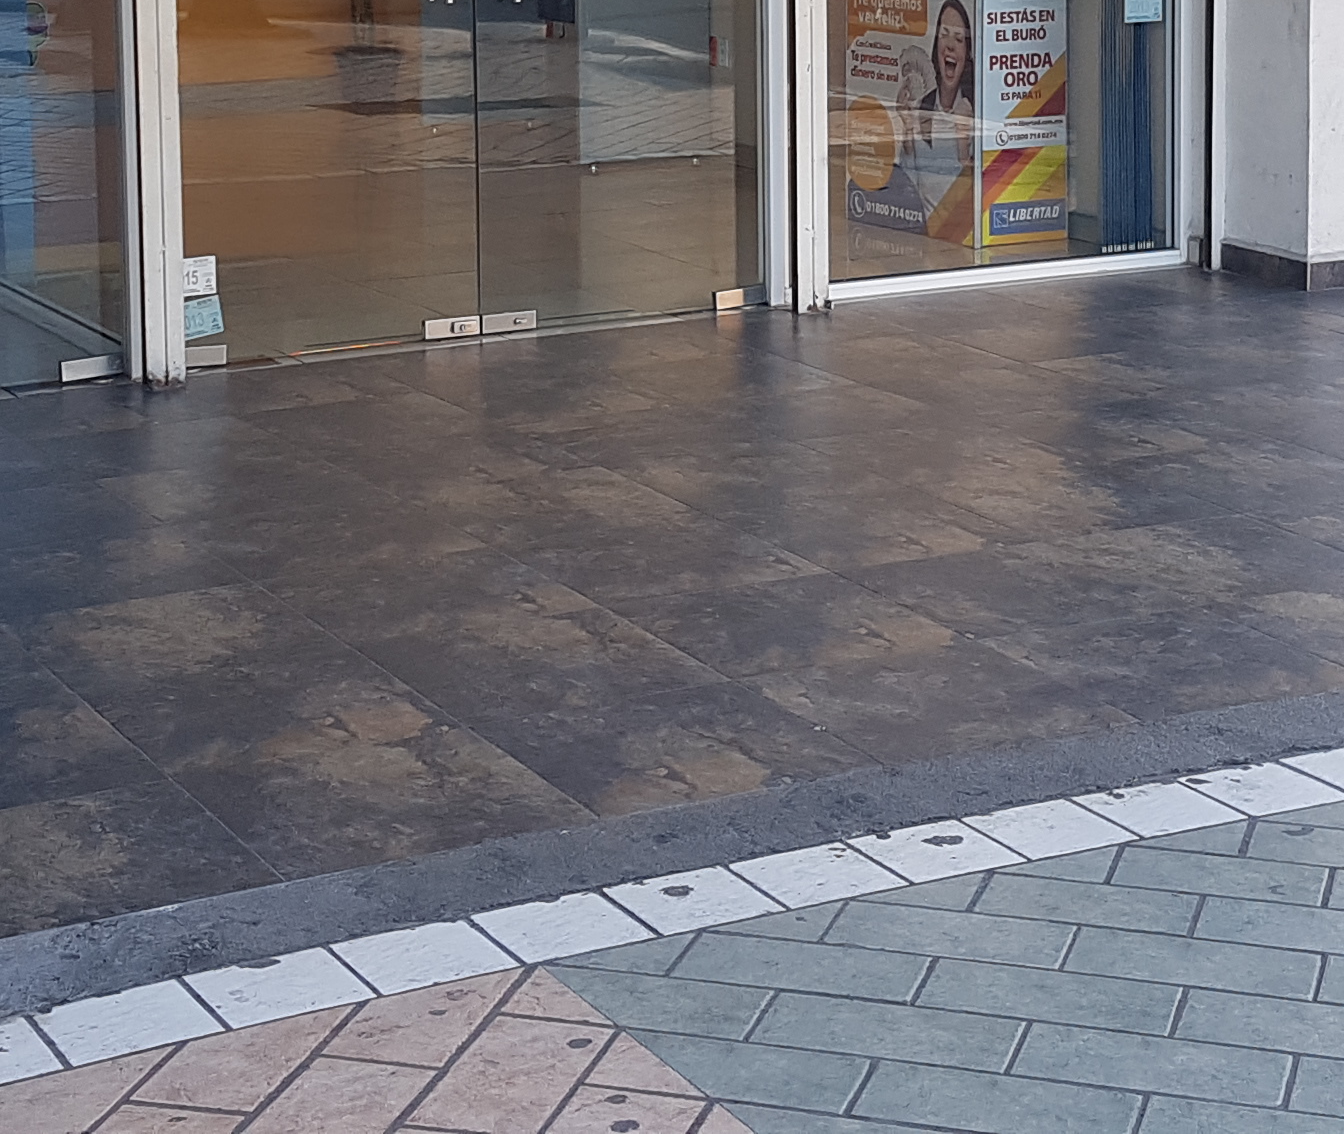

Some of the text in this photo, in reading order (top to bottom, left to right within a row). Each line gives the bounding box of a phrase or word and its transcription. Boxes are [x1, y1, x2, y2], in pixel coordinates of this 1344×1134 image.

[986, 8, 1055, 25] SI ESTÁS EN
[995, 25, 1047, 43] EL BURÓ
[989, 52, 1054, 71] PRENDA
[1003, 70, 1039, 88] ORO
[1000, 92, 1011, 102] ES
[1011, 91, 1035, 101] PARA
[1008, 205, 1061, 223] LIBERTAD
